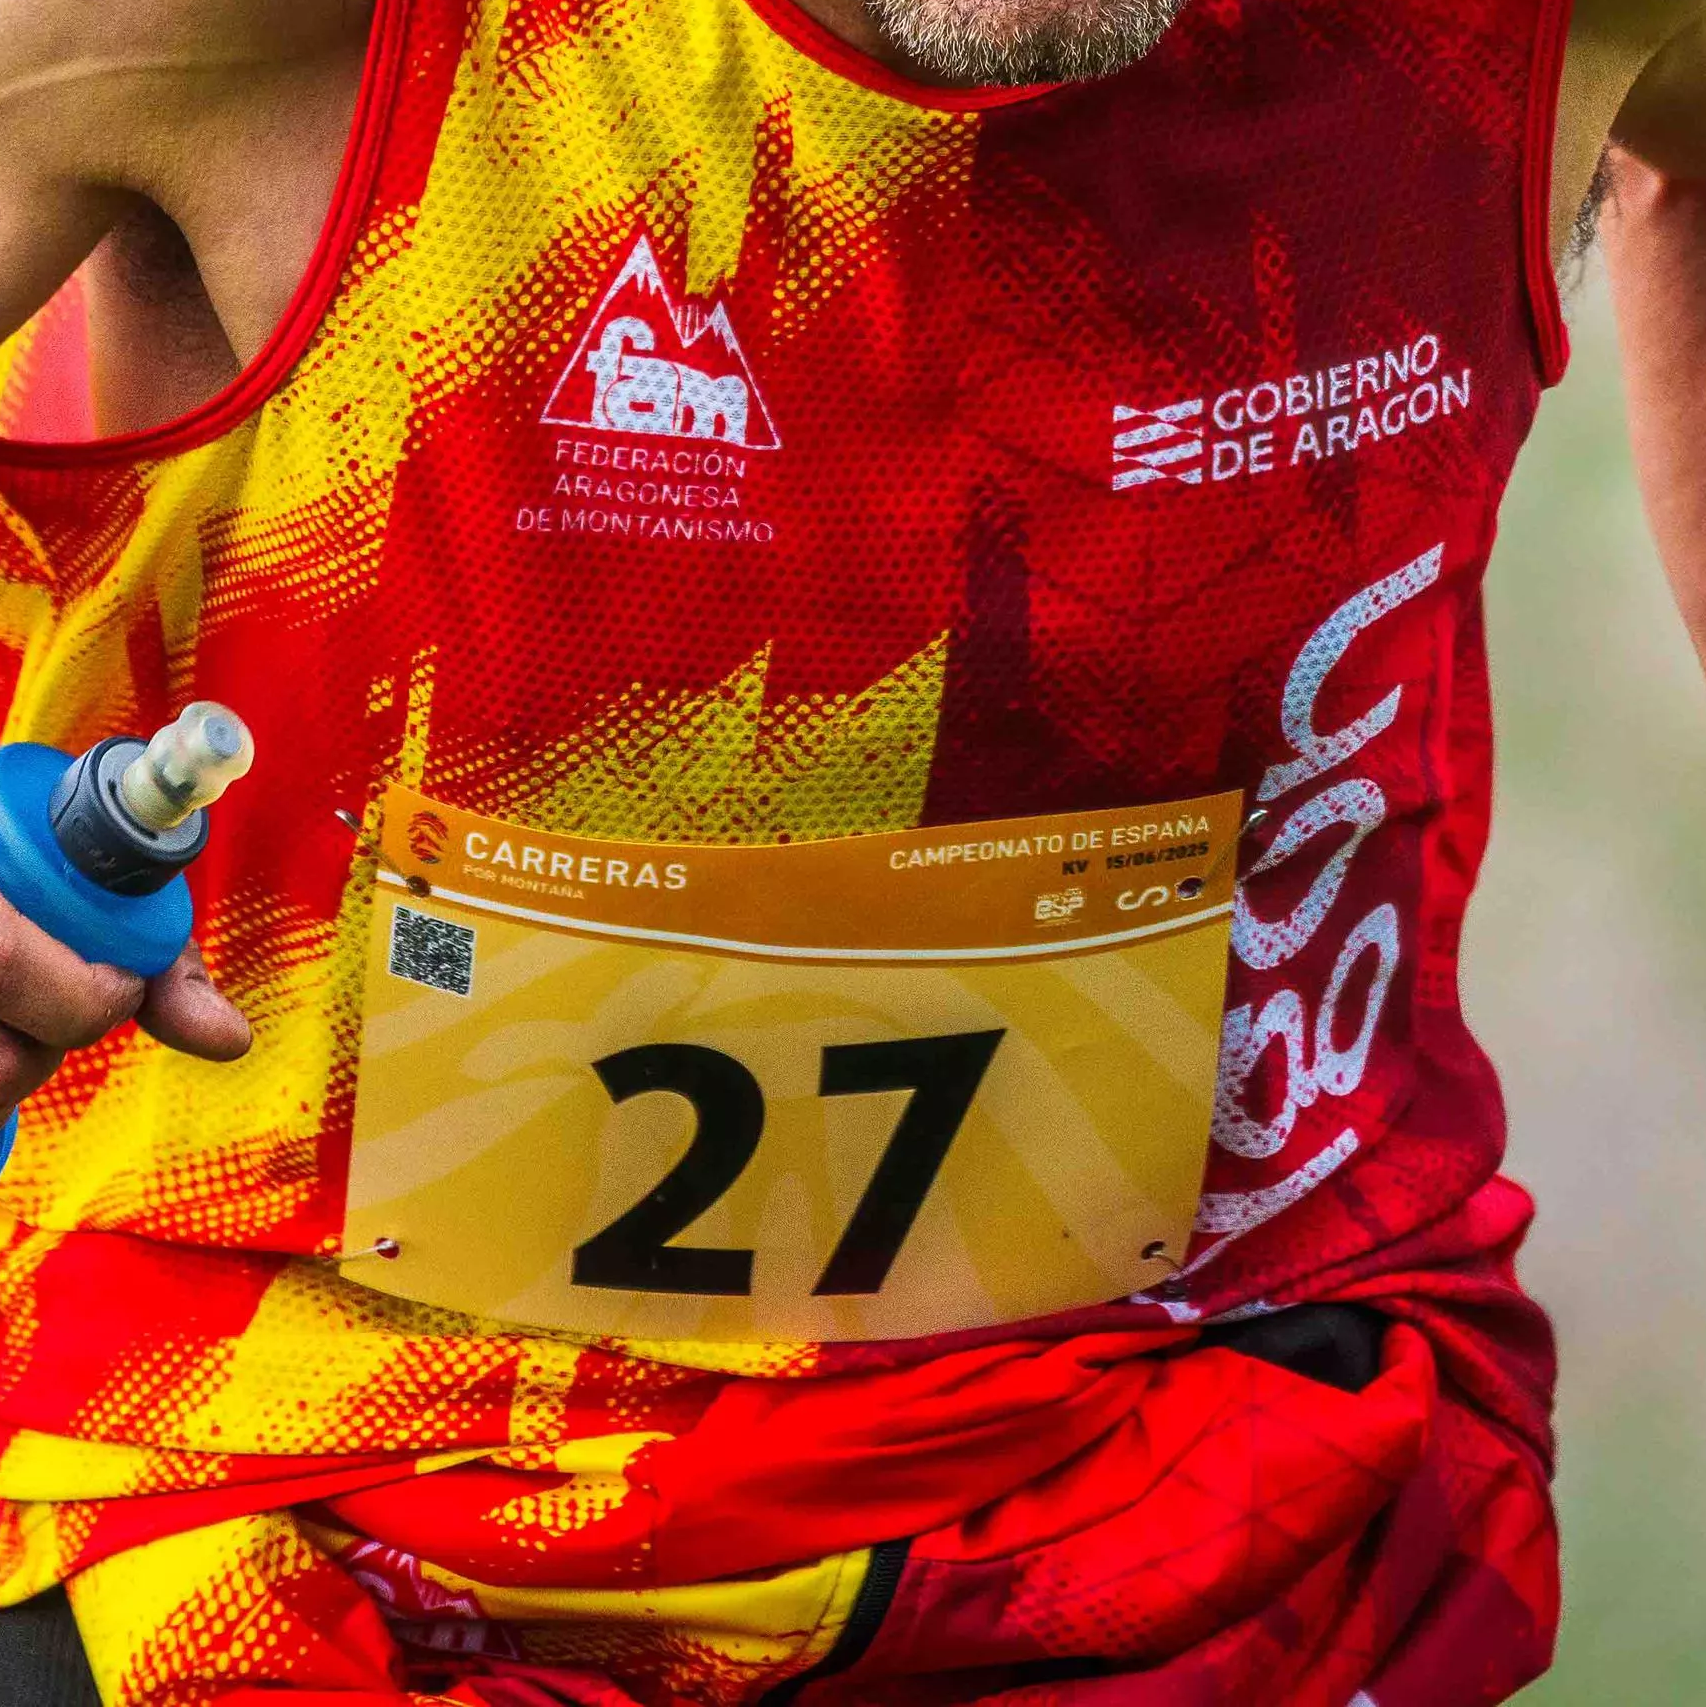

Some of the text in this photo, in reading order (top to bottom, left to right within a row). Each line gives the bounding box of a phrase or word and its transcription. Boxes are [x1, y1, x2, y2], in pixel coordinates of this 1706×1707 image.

[587, 315, 749, 443] fam
[1212, 334, 1439, 432] GOBIERNO
[554, 438, 746, 478] FEDERACIÓN
[1211, 431, 1274, 482] DE
[553, 473, 740, 509] ARAGONESA
[515, 507, 774, 543] DE MONTAÑISMO
[465, 831, 688, 890] CARRERAS
[889, 814, 1210, 870] CAMPEONATO DE ESPAÑA
[1061, 842, 1210, 876] KV 15/06/2025
[462, 864, 585, 901] POR MONTAÑA
[570, 1027, 1008, 1297] 27
